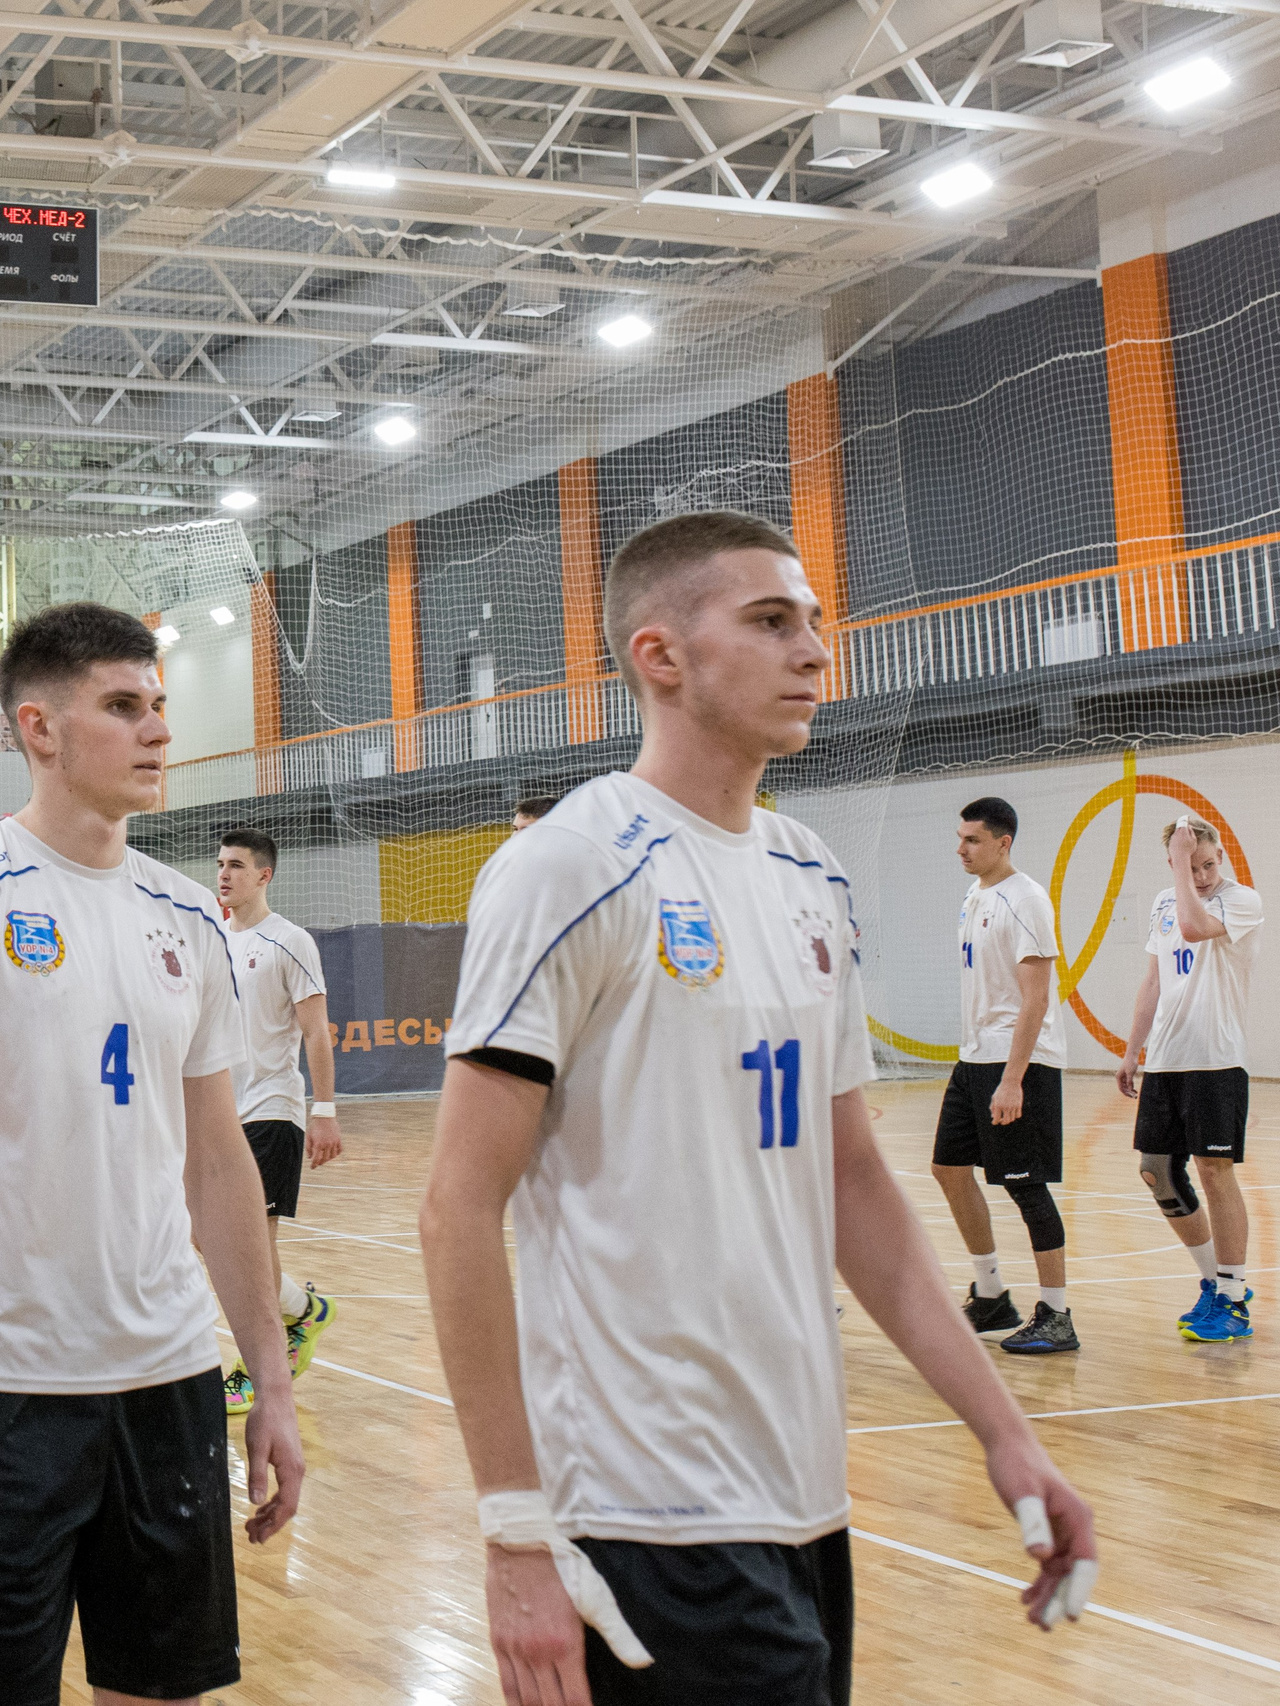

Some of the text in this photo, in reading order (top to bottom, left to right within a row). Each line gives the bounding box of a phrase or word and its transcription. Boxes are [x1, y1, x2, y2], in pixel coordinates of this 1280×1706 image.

[51, 274, 79, 283] ФОЛЫ
[1173, 949, 1194, 975] 10
[101, 1023, 134, 1105] 4
[741, 1039, 801, 1149] 11
